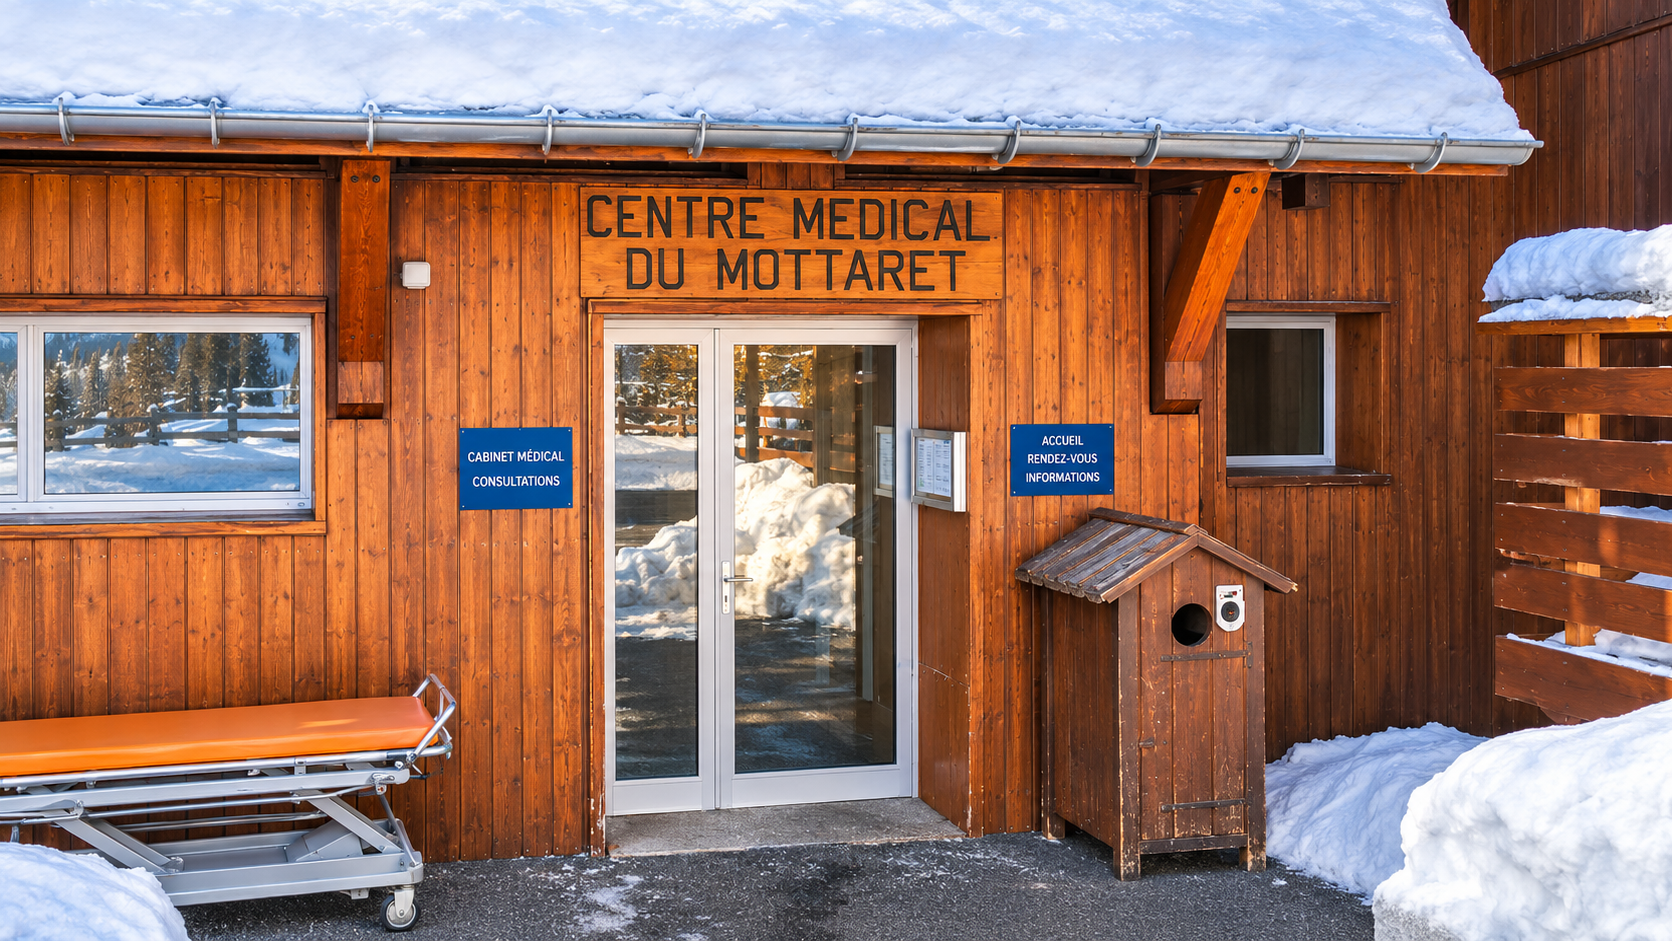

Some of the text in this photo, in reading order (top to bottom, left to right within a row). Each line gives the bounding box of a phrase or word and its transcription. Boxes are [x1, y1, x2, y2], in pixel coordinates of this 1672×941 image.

[586, 194, 992, 242] CENTRE MEDICAL
[626, 248, 967, 292] DU MOTTARET
[1041, 435, 1084, 446] ACCUEIL
[467, 448, 565, 463] CABINET MÉDICAL
[1027, 453, 1098, 464] RENDEZ-VOUS
[472, 475, 561, 488] CONSULTATIONS
[1025, 471, 1100, 483] INFORMATIONS
